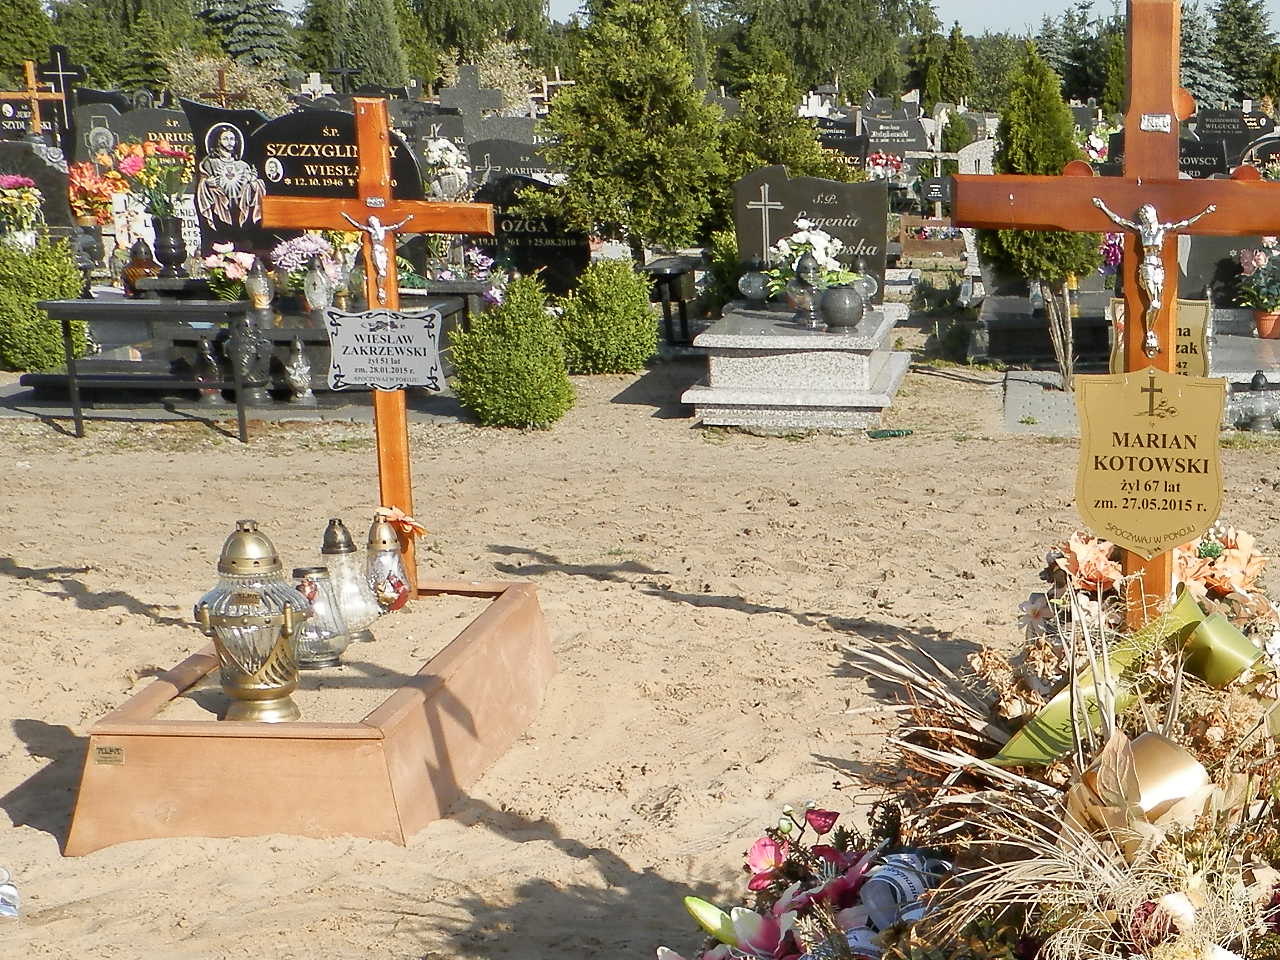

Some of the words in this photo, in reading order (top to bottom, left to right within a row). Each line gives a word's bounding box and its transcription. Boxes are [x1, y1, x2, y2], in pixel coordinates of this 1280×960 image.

[342, 345, 428, 358] ZAKRZEWSKI
[1112, 431, 1198, 450] MARIAN
[1094, 455, 1209, 474] KOTOWSKI
[1144, 480, 1160, 492] 67
[1164, 480, 1181, 493] lat
[1094, 499, 1118, 509] zm.
[1122, 498, 1193, 512] 27.05.2015
[1196, 502, 1207, 512] r.
[1105, 522, 1152, 544] SPOCZYWAJ
[1163, 524, 1196, 541] POKOJU
